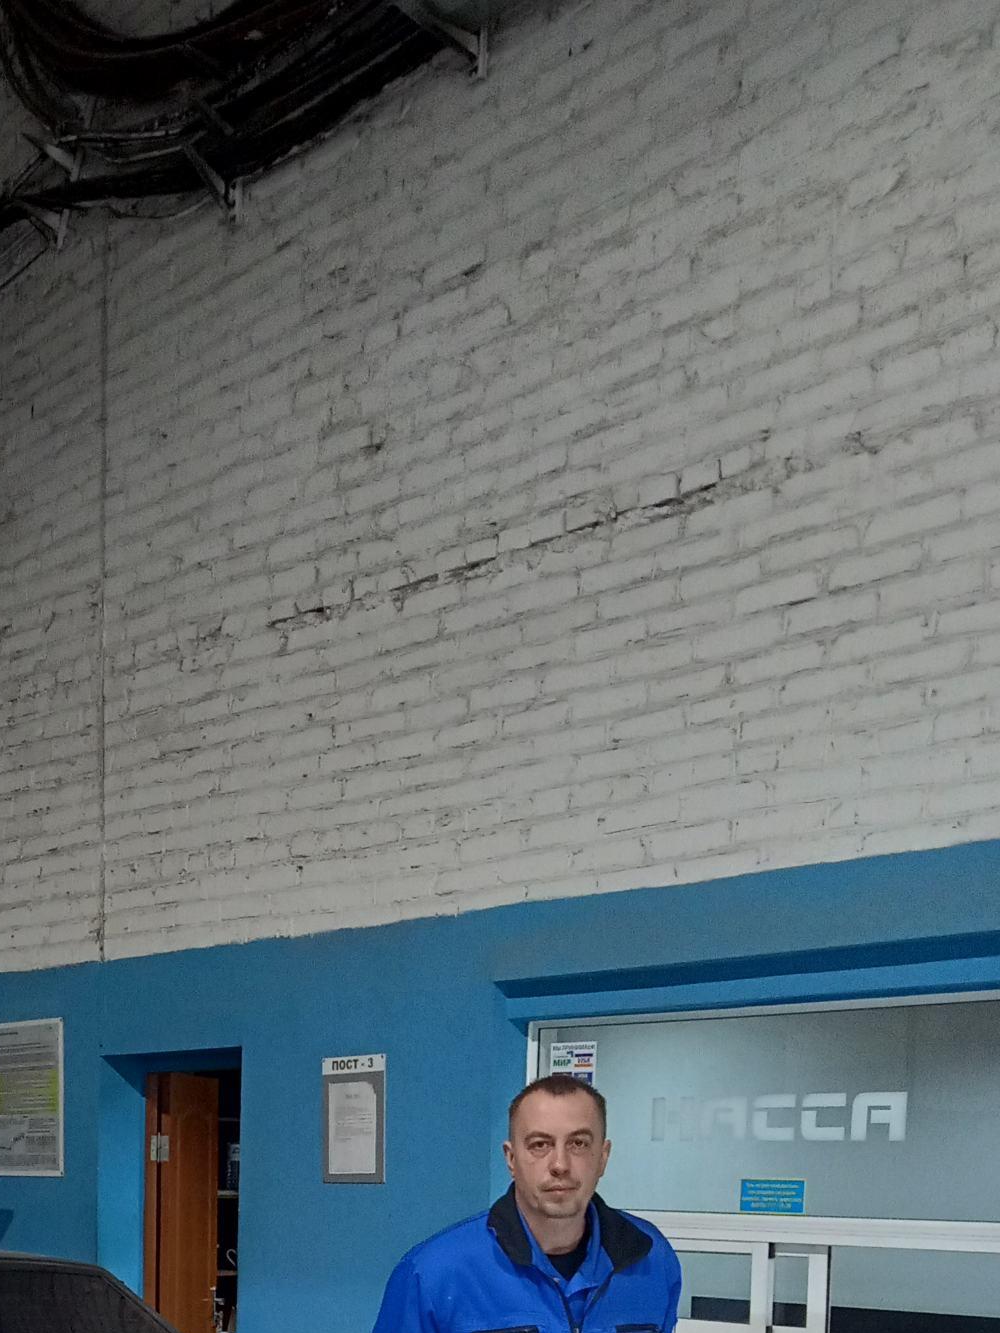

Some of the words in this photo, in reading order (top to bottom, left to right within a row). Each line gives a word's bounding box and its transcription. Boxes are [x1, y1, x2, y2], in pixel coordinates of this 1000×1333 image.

[332, 1058, 359, 1071] ПОСТ
[367, 1057, 374, 1069] 3
[552, 1058, 572, 1067] МИР
